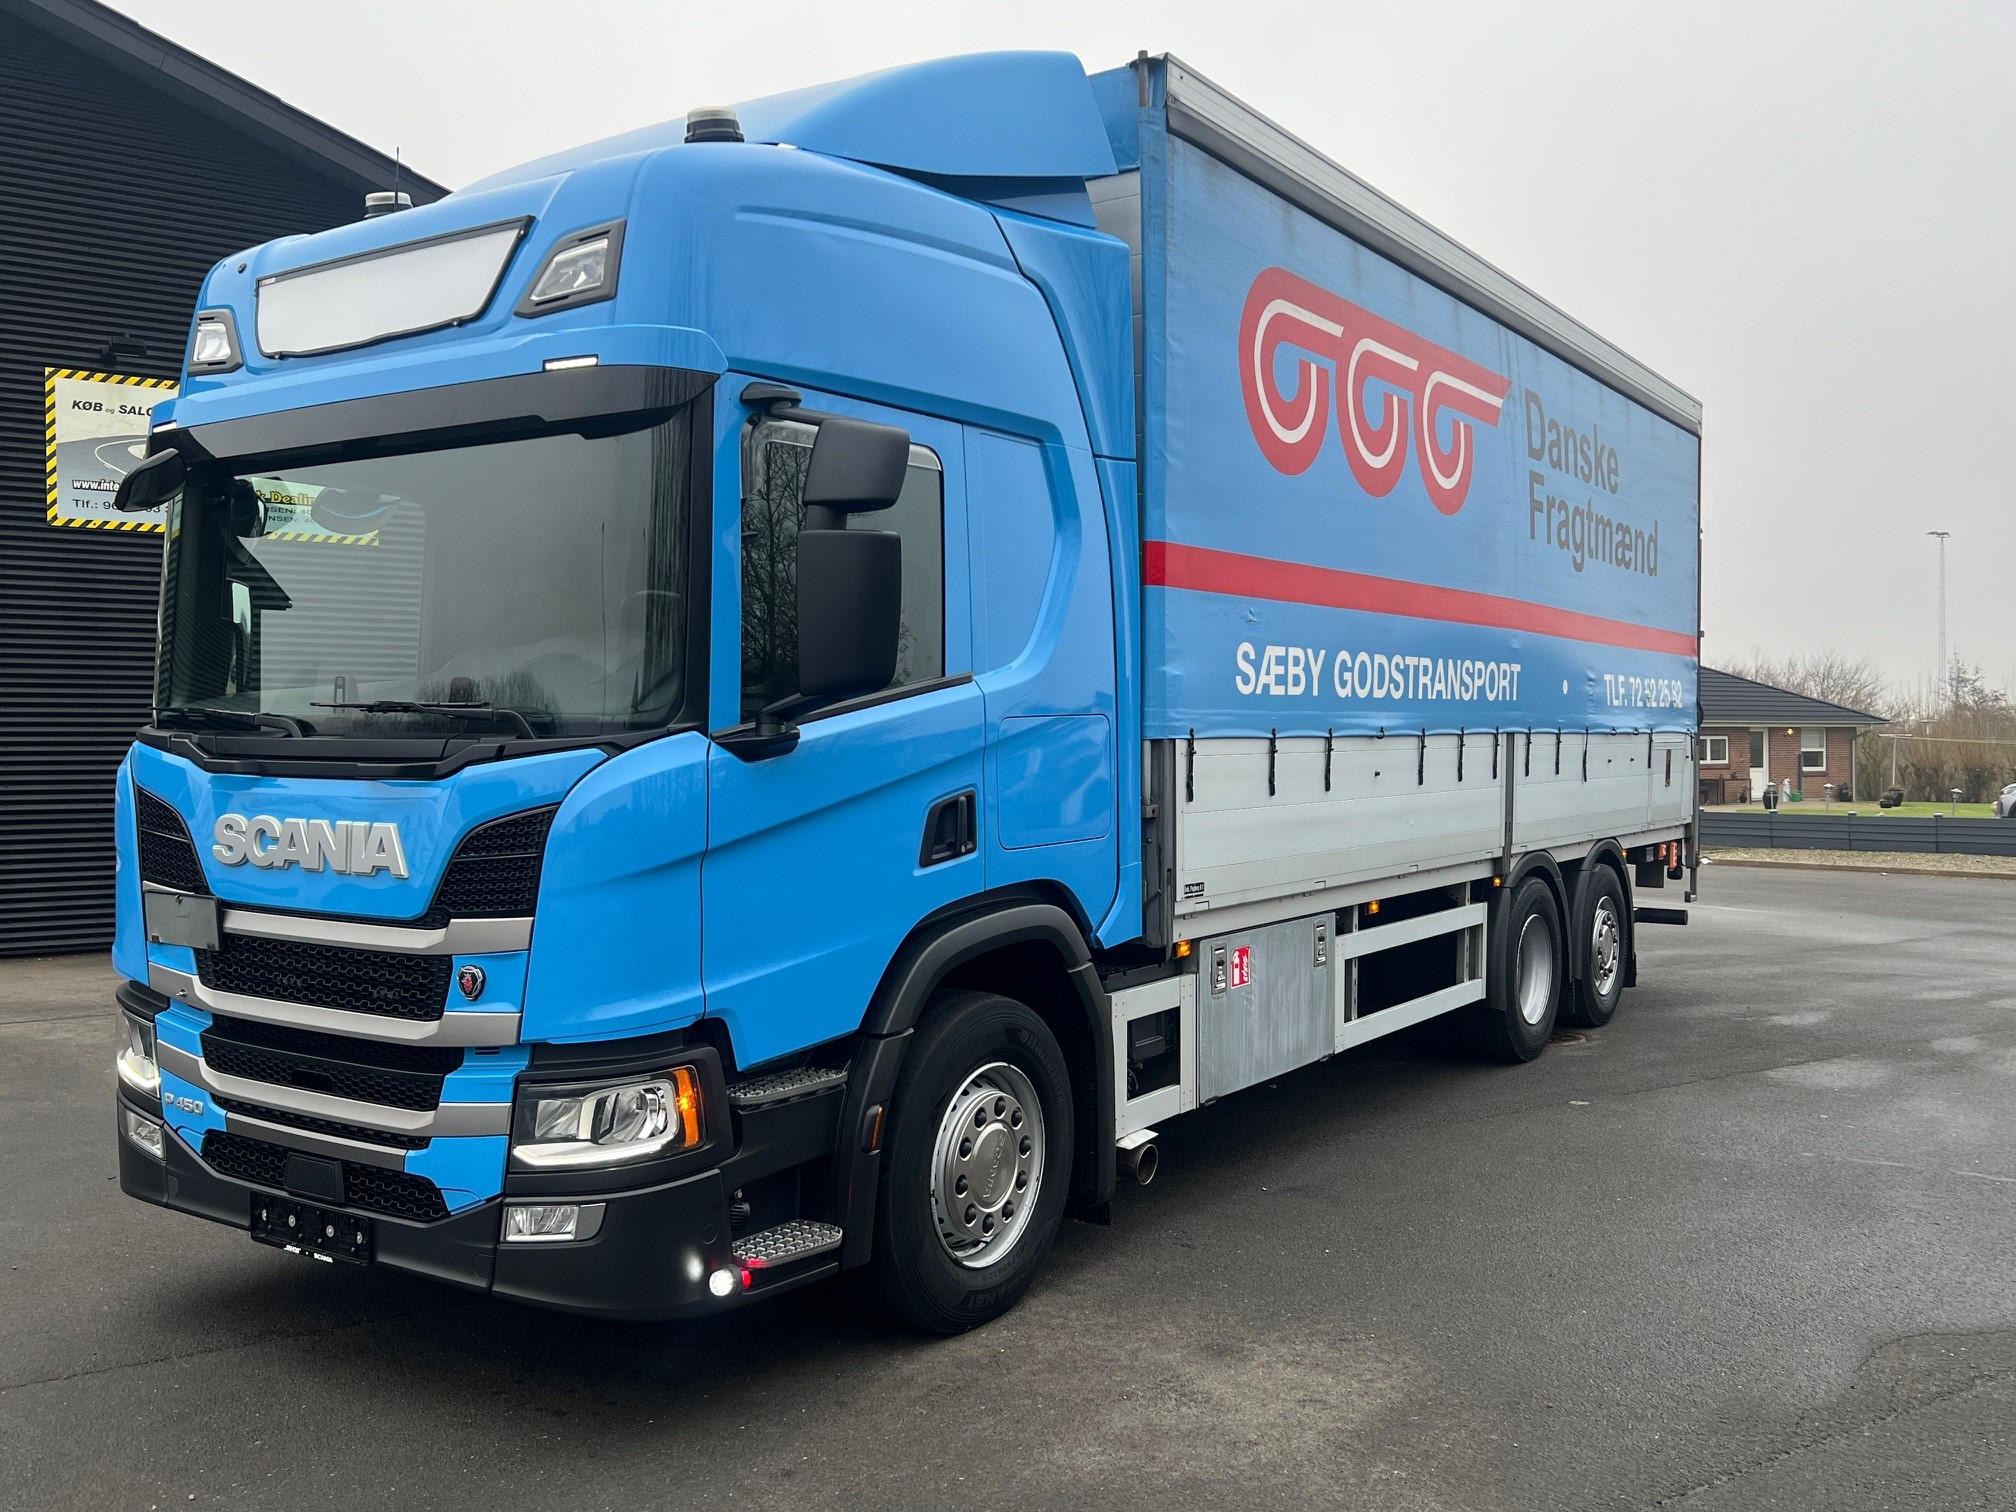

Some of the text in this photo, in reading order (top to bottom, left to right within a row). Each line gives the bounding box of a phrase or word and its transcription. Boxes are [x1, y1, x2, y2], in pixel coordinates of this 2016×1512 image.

[72, 400, 103, 412] KØB
[1525, 388, 1619, 495] Danske
[1529, 470, 1658, 577] Fragtmænd
[1235, 641, 1326, 696] SÆBY
[1333, 650, 1521, 701] GODSTRANSPORT
[1604, 673, 1628, 707] TLF.
[1629, 676, 1643, 707] 72
[1658, 678, 1671, 708] 25
[212, 814, 410, 879] SCANIA
[164, 1092, 204, 1116] P 450
